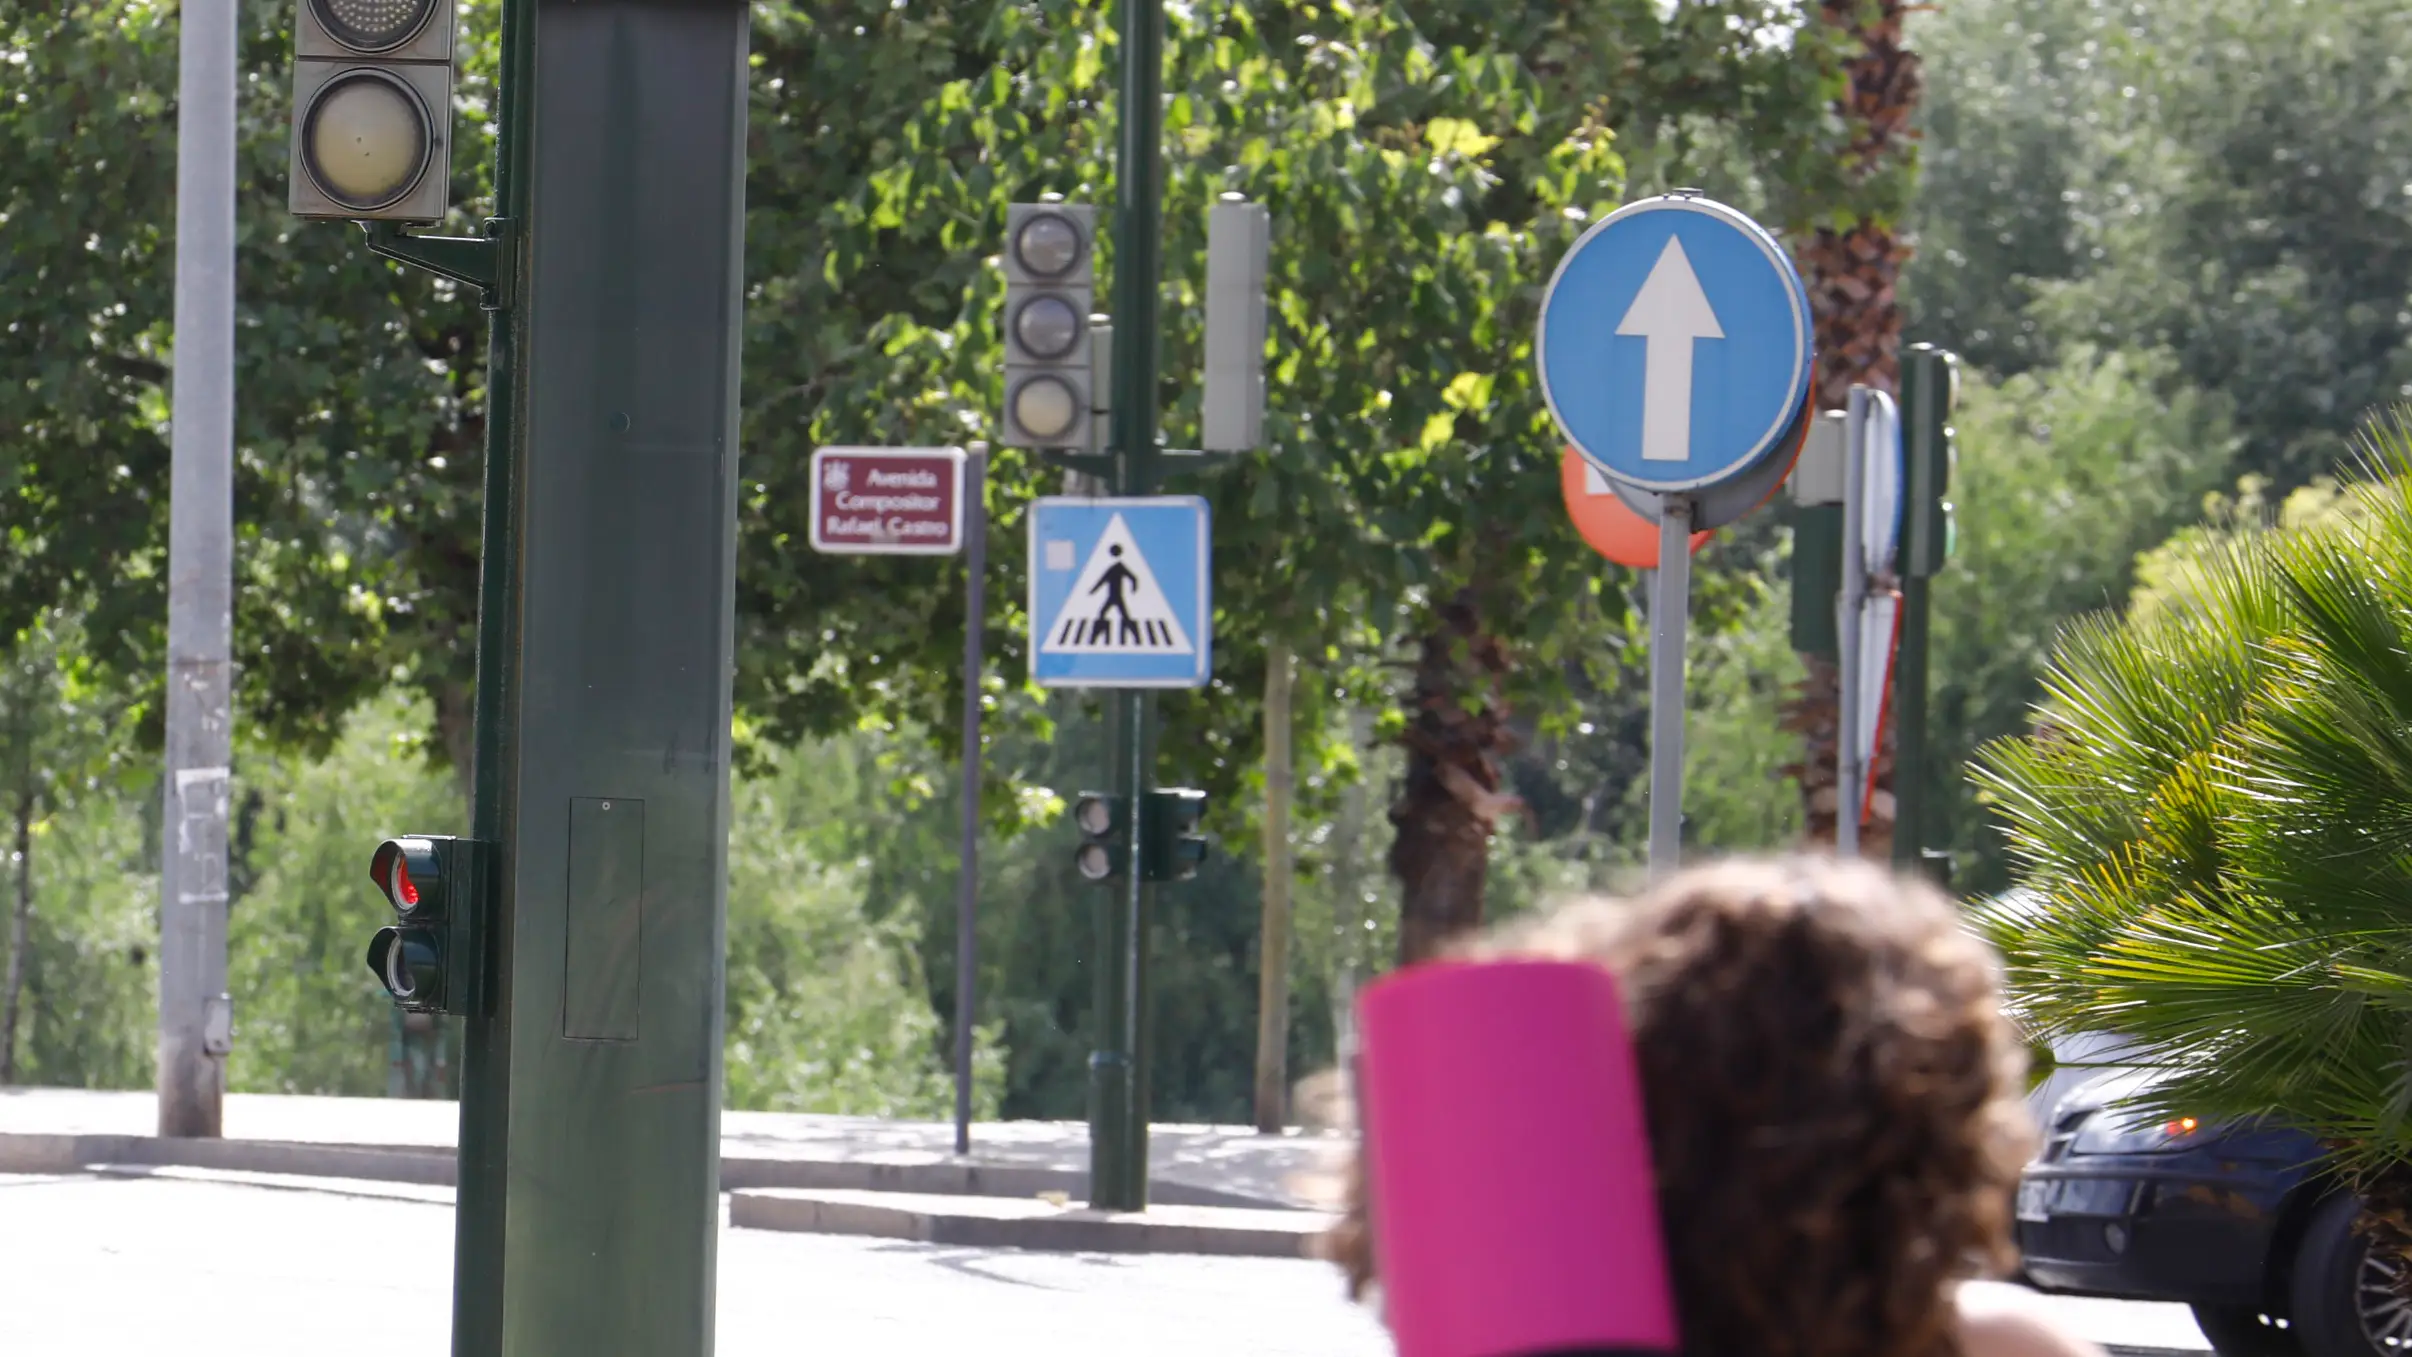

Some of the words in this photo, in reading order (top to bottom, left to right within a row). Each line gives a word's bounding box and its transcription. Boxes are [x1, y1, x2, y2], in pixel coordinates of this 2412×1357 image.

[866, 468, 938, 488] Avenida
[835, 490, 941, 513] Compositor
[826, 515, 883, 536] Rafael
[886, 516, 949, 537] Castro
